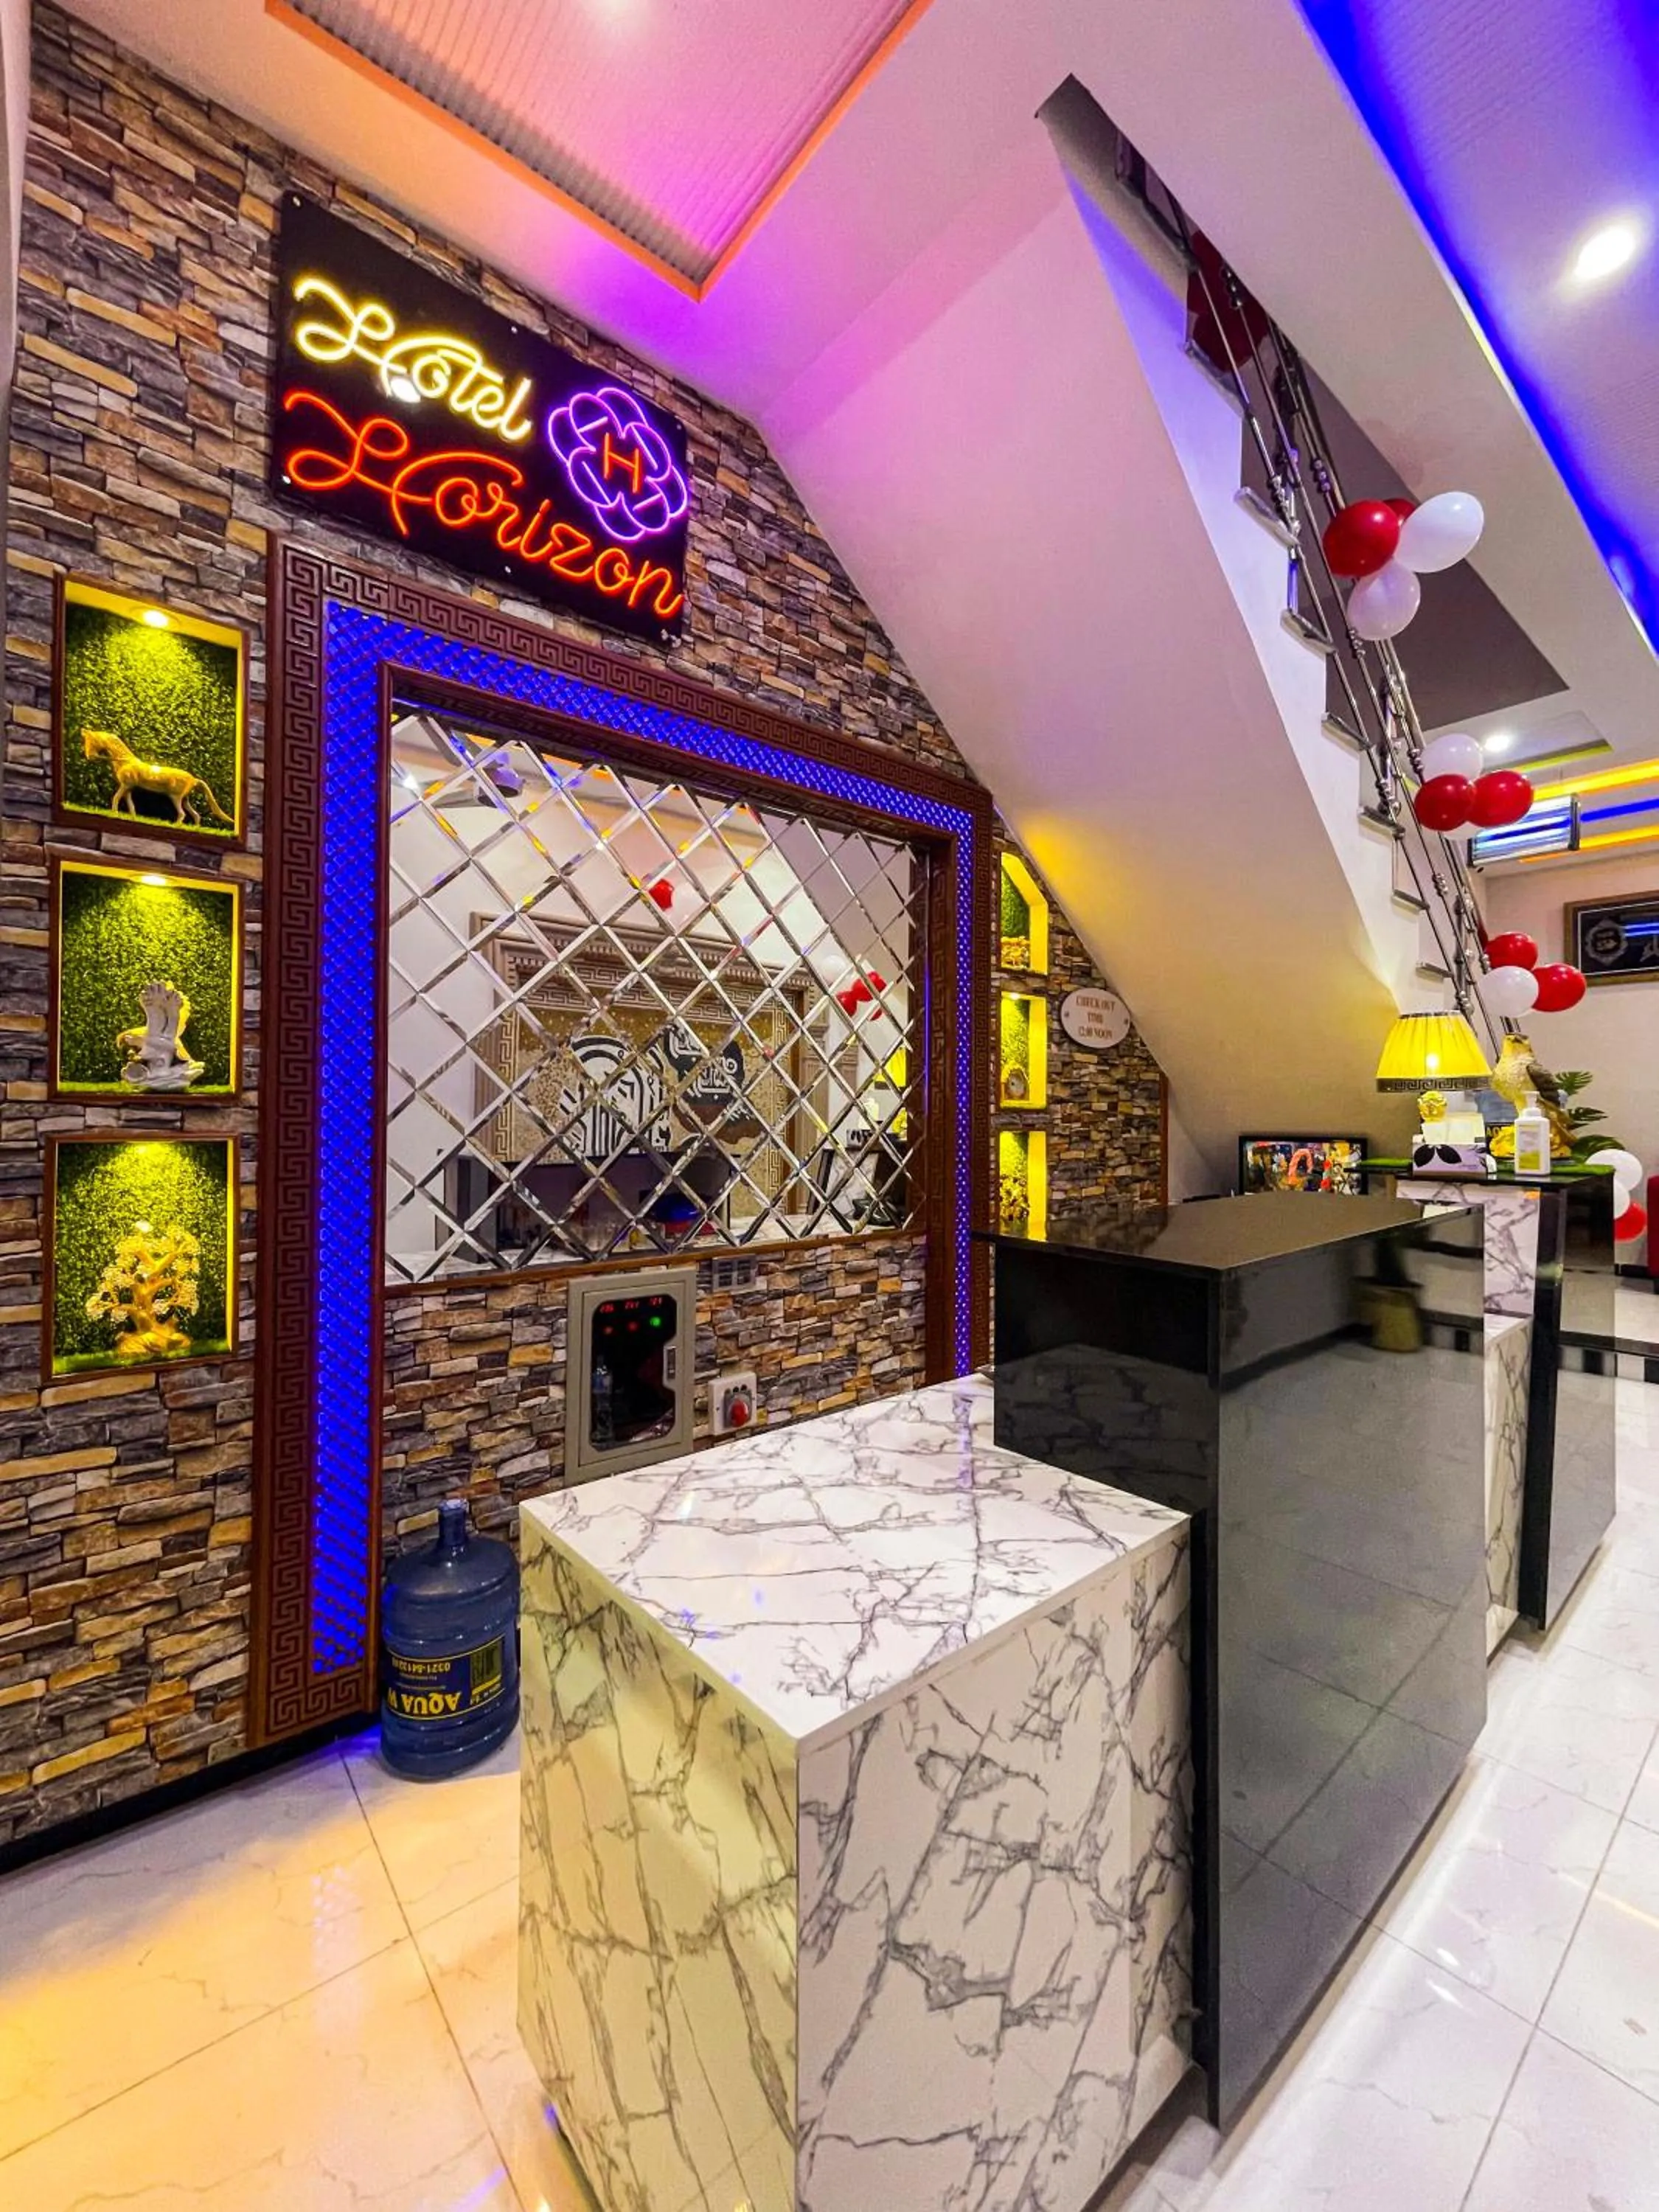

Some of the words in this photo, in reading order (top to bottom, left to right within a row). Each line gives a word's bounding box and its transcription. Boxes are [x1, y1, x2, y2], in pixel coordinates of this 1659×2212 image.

[294, 277, 532, 441] Hotel
[284, 392, 684, 618] Horizon
[603, 431, 641, 494] H
[400, 1691, 462, 1715] AQUA
